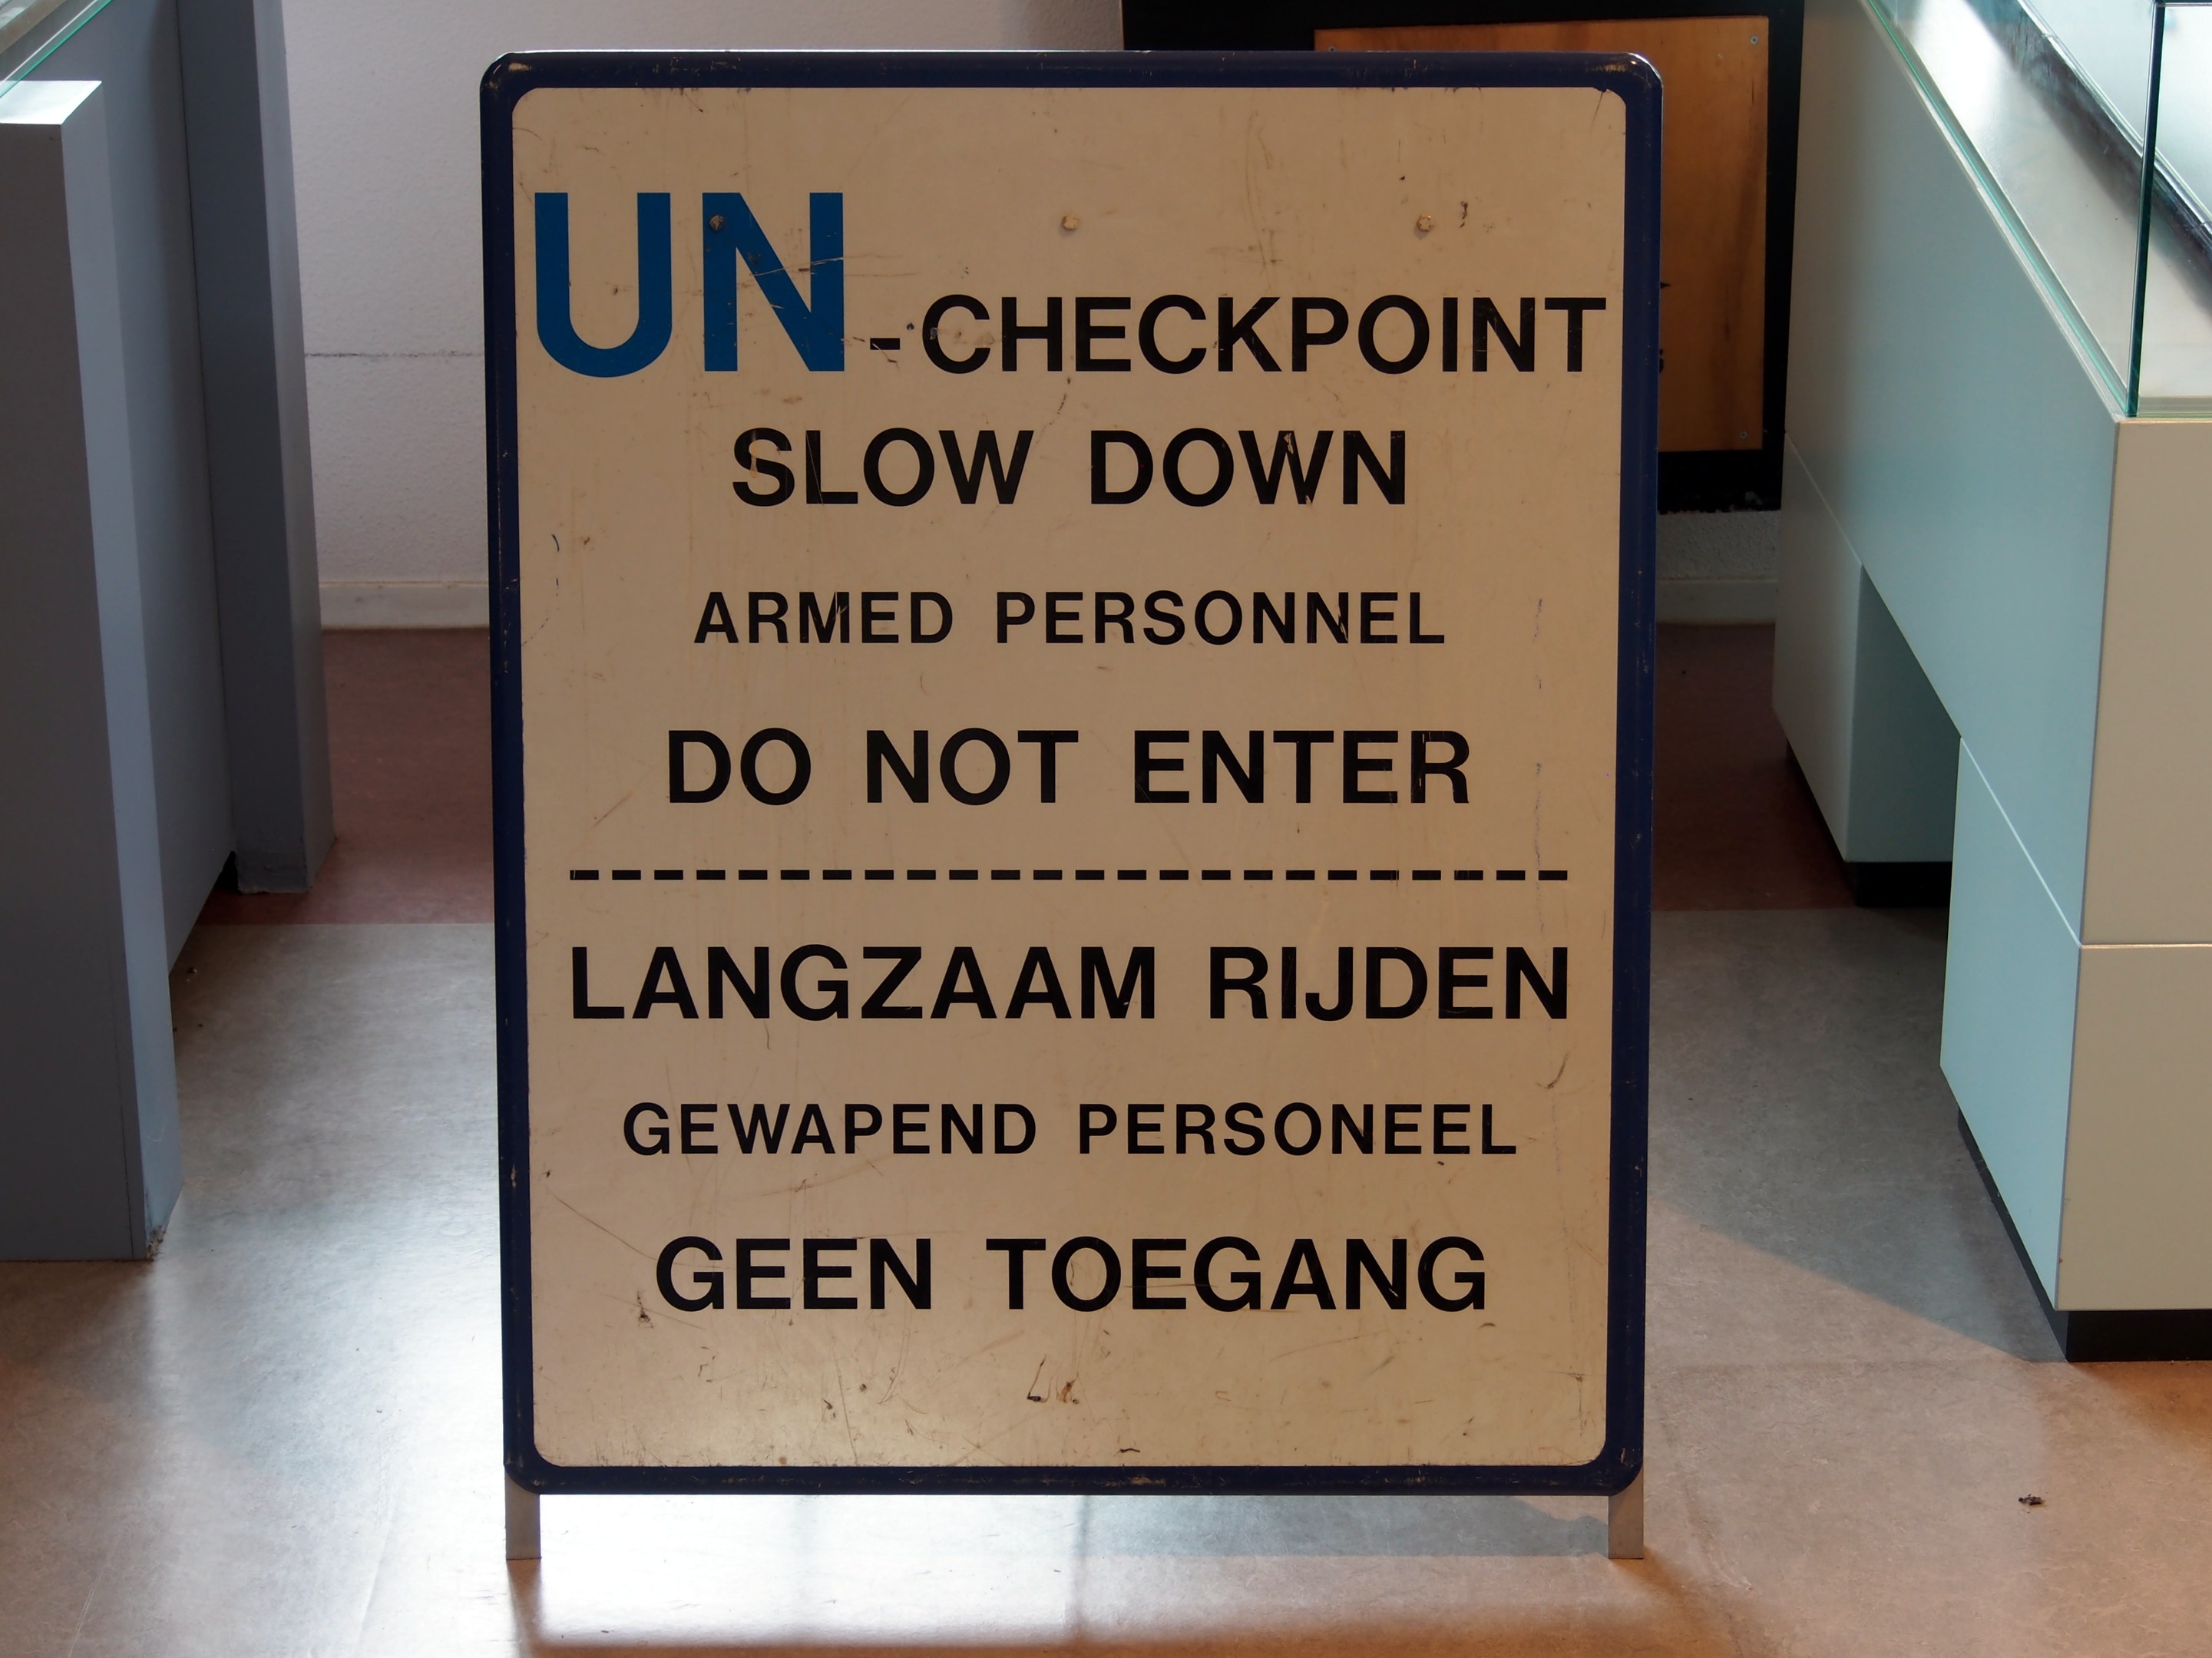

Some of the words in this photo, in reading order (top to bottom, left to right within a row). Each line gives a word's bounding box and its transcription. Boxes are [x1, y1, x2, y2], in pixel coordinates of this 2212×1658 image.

[733, 428, 1033, 507] SLOW
[1091, 428, 1405, 507] DOWN
[694, 591, 952, 644] ARMED
[997, 590, 1444, 646] PERSONNEL
[669, 728, 811, 805] DO
[867, 728, 1078, 806] NOT
[1135, 730, 1469, 804] ENTER
[573, 944, 1154, 1022] LANGZAAM
[1211, 946, 1567, 1022] RIJDEN
[624, 1102, 1036, 1156] GEWAPEND
[1080, 1102, 1516, 1156] PERSONEEL
[656, 1237, 931, 1312] GEEN
[987, 1236, 1484, 1313] TOEGANG
